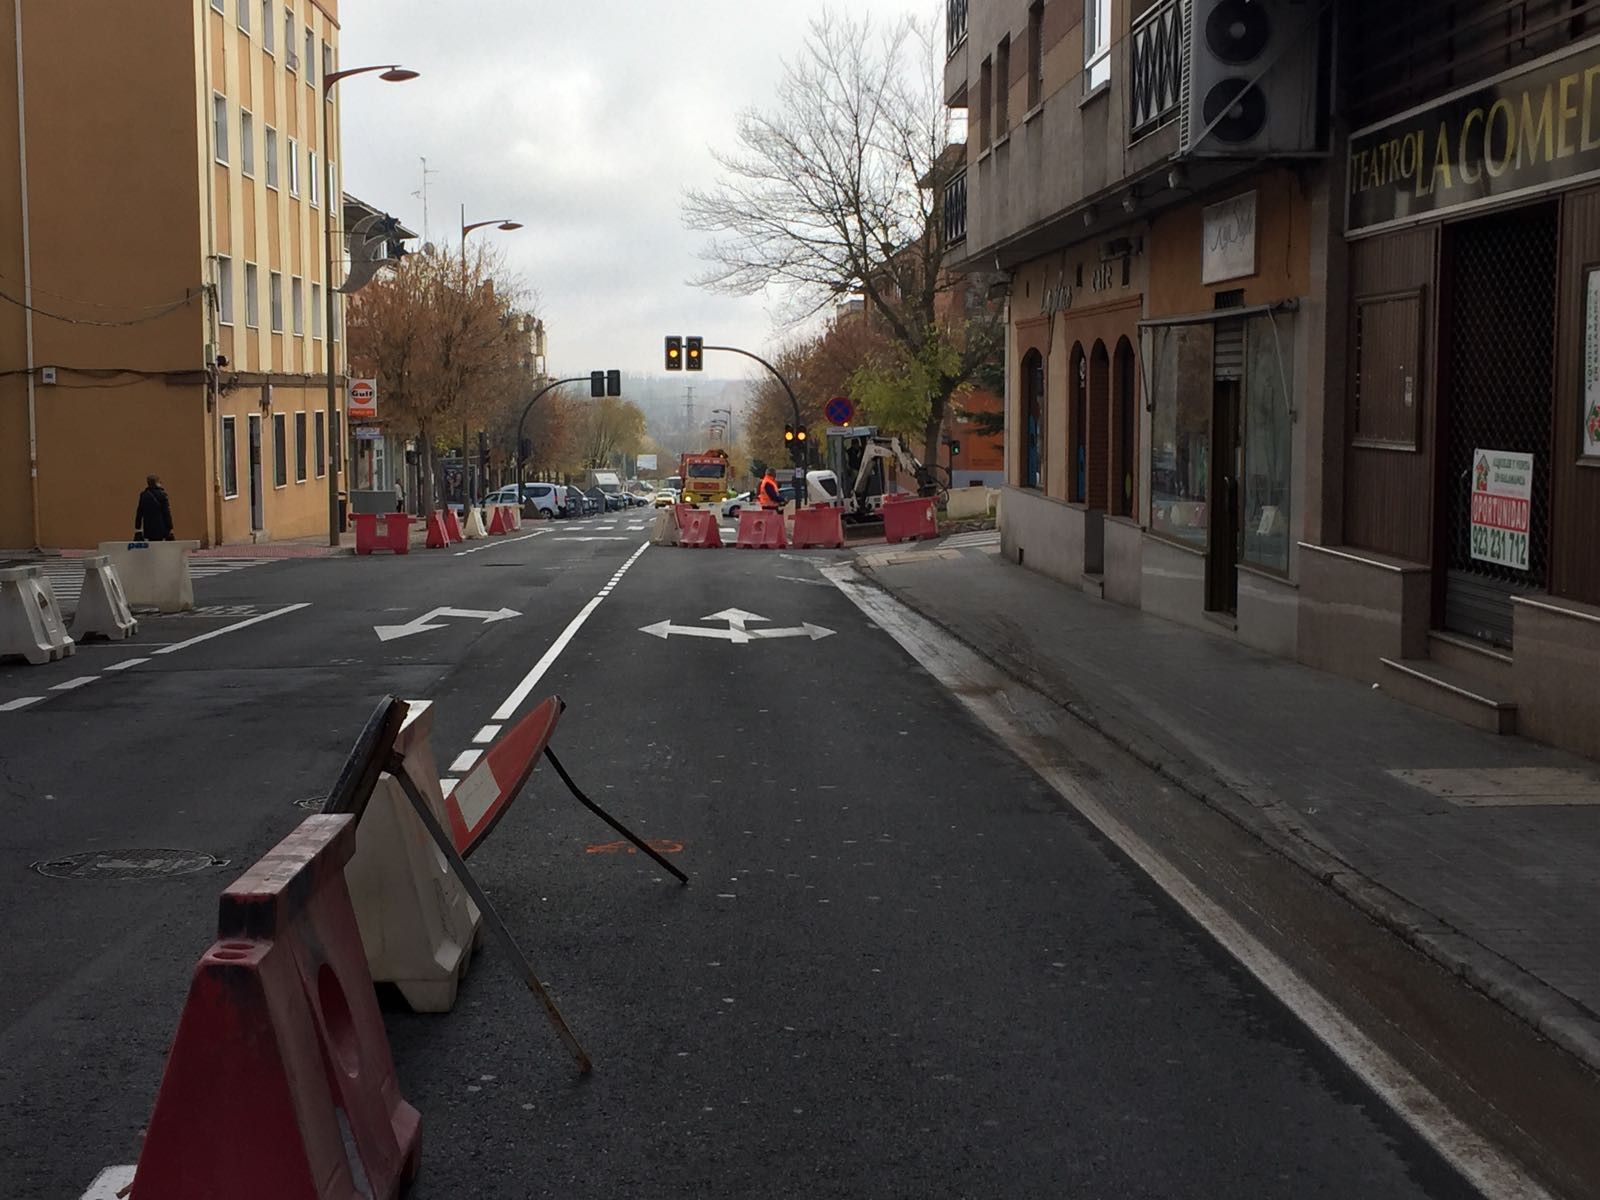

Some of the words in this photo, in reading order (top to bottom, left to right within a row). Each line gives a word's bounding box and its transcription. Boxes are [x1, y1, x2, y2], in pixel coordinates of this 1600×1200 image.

[1350, 132, 1417, 194] TEATRO
[1415, 121, 1453, 198] LA
[1472, 494, 1528, 531] OPORTUNIDAD
[1473, 525, 1488, 556] 923
[1490, 528, 1506, 561] 231
[1509, 532, 1526, 565] 712
